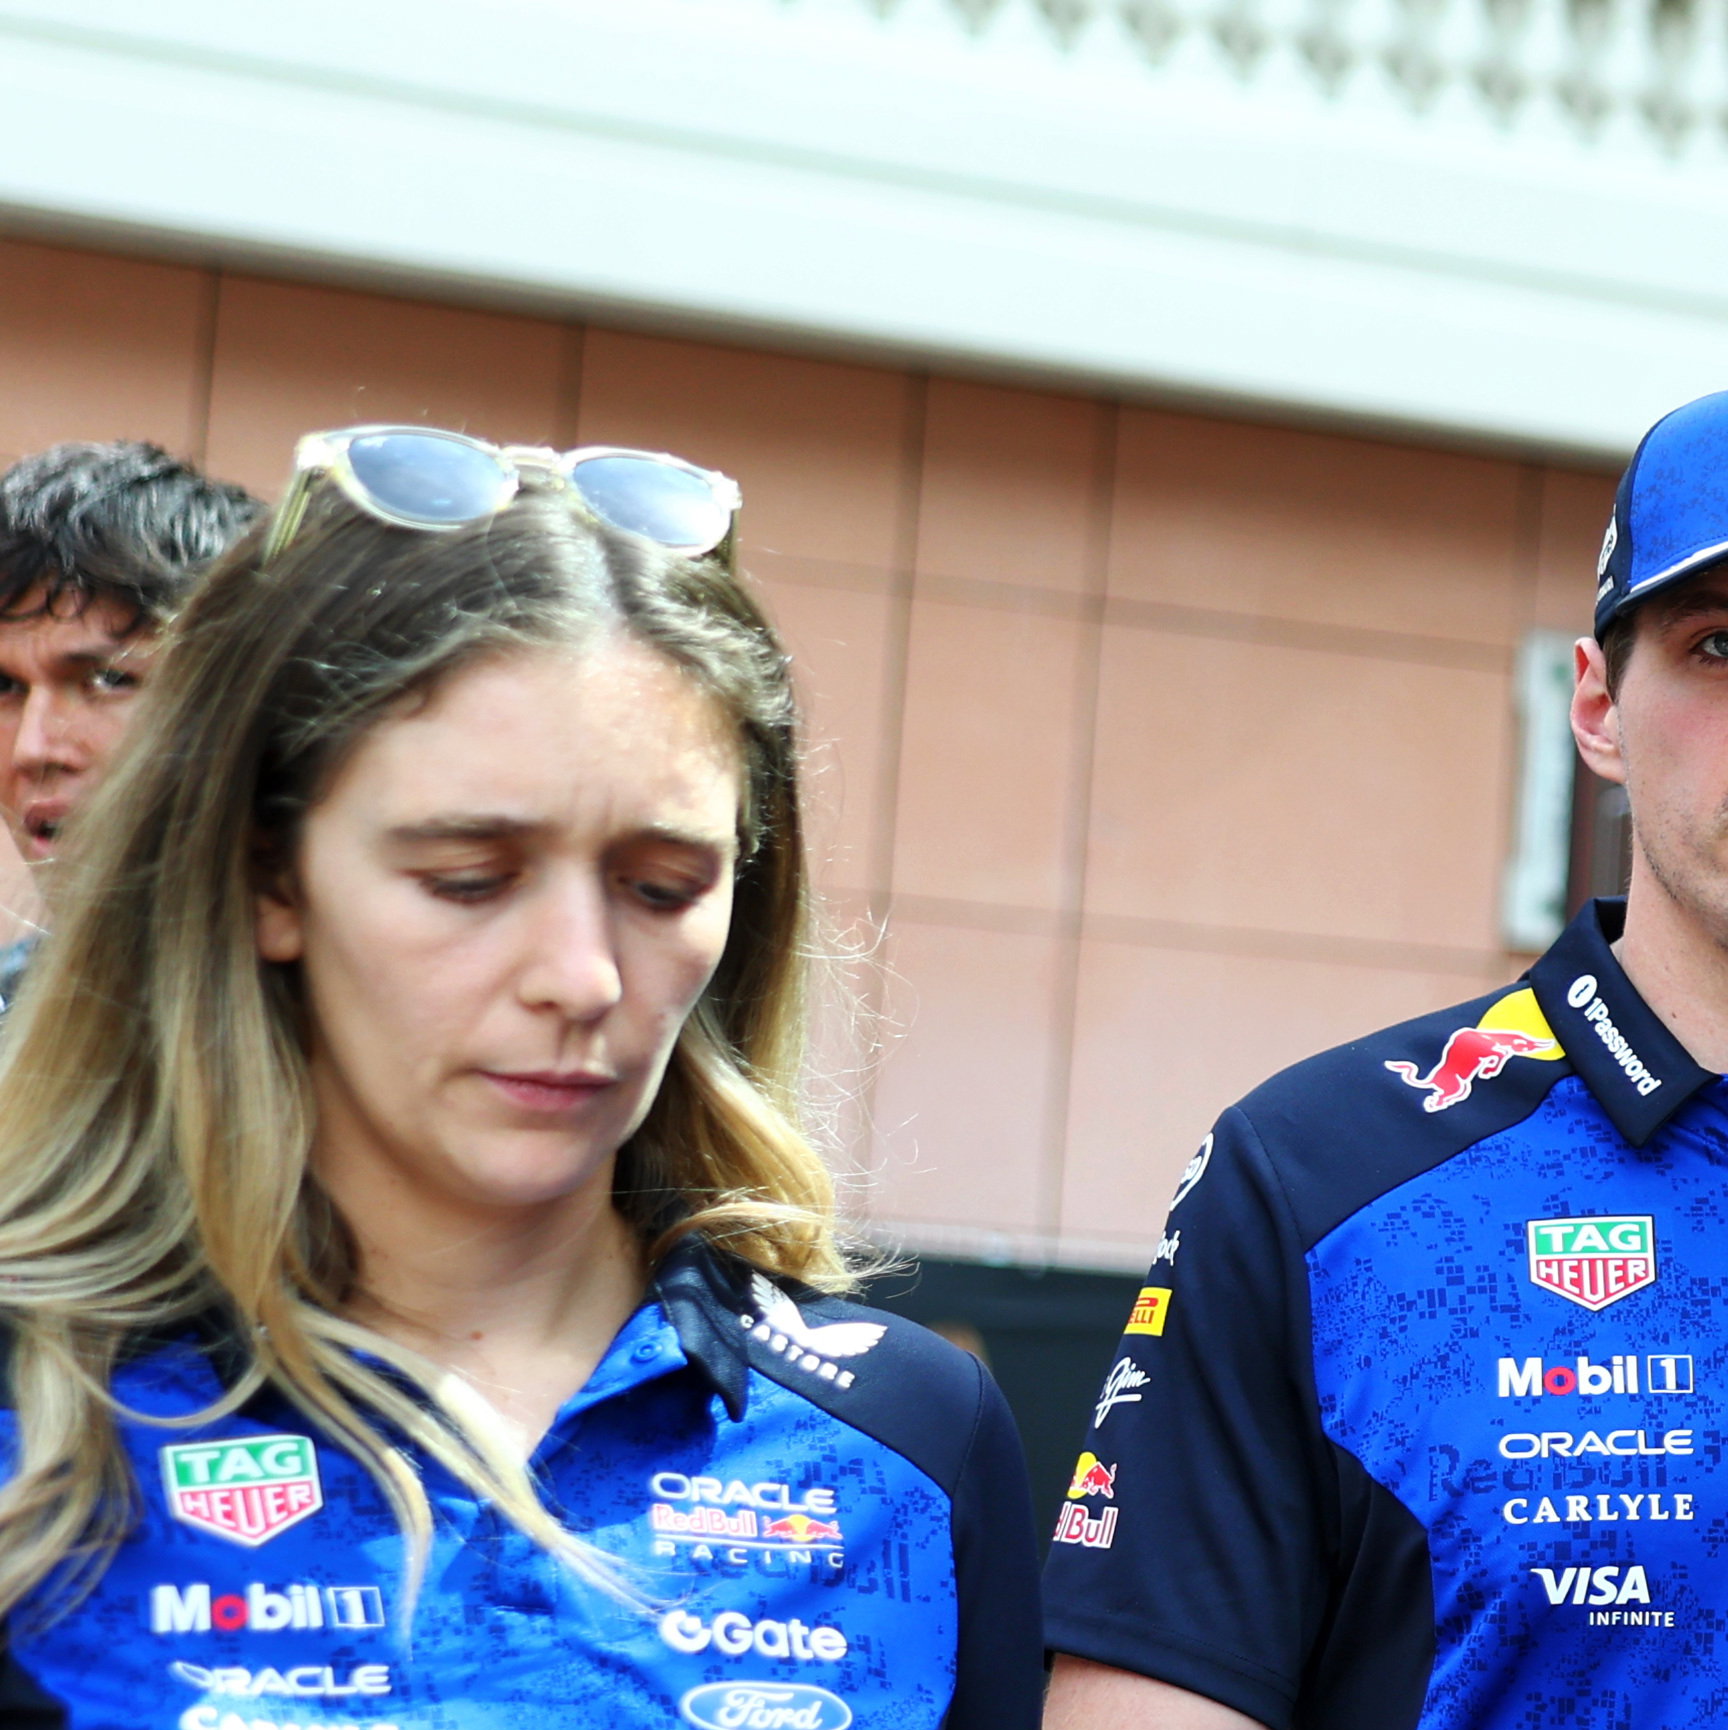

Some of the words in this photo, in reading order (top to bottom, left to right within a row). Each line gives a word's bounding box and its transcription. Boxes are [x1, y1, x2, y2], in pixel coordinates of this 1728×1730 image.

[1584, 996, 1662, 1097] 1Password
[1538, 1223, 1643, 1252] TAG
[1539, 1259, 1647, 1303] HEUER
[1497, 1355, 1640, 1397] Mobil
[177, 1441, 303, 1483] TAG
[1499, 1429, 1695, 1459] ORACLE
[180, 1483, 312, 1534] HEUER
[651, 1472, 838, 1514] ORACLE
[1502, 1493, 1694, 1525] CARLYLE
[1065, 1503, 1119, 1550] Bull
[654, 1540, 845, 1569] RACING
[1530, 1565, 1651, 1606] VISA
[153, 1582, 324, 1634] Mobil
[1589, 1611, 1675, 1628] INFINITE
[711, 1611, 849, 1660] Gate
[717, 1688, 823, 1730] Ford
